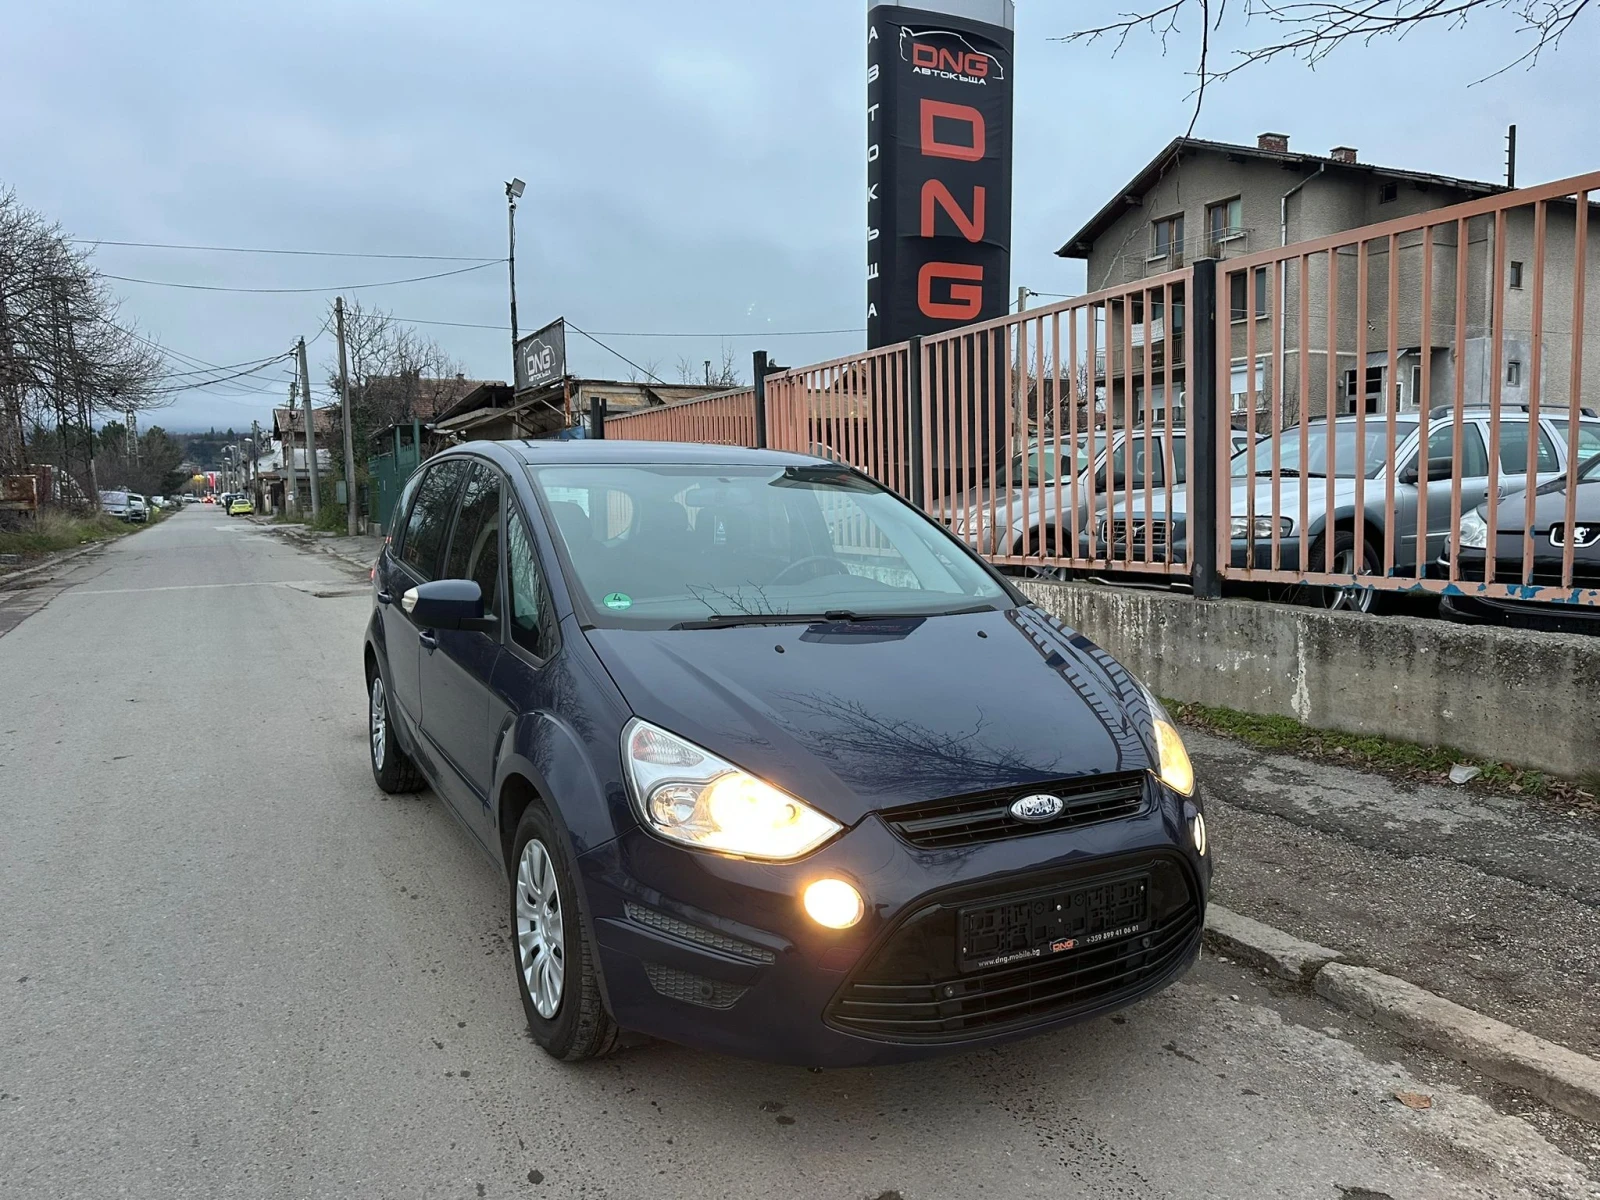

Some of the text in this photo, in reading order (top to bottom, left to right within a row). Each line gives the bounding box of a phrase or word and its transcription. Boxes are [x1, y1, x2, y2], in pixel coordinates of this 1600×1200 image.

[912, 43, 988, 77] DNG
[912, 66, 987, 86] АВТОКЪЩА
[917, 98, 986, 321] DNG
[527, 348, 550, 376] DNG
[613, 593, 622, 602] 4
[1086, 933, 1103, 944] +359
[1103, 930, 1115, 940] 899
[1115, 928, 1122, 936] 41
[1123, 926, 1132, 934] 06
[1052, 939, 1074, 951] DNG
[978, 948, 1041, 967] www.dng.mobile.bg
